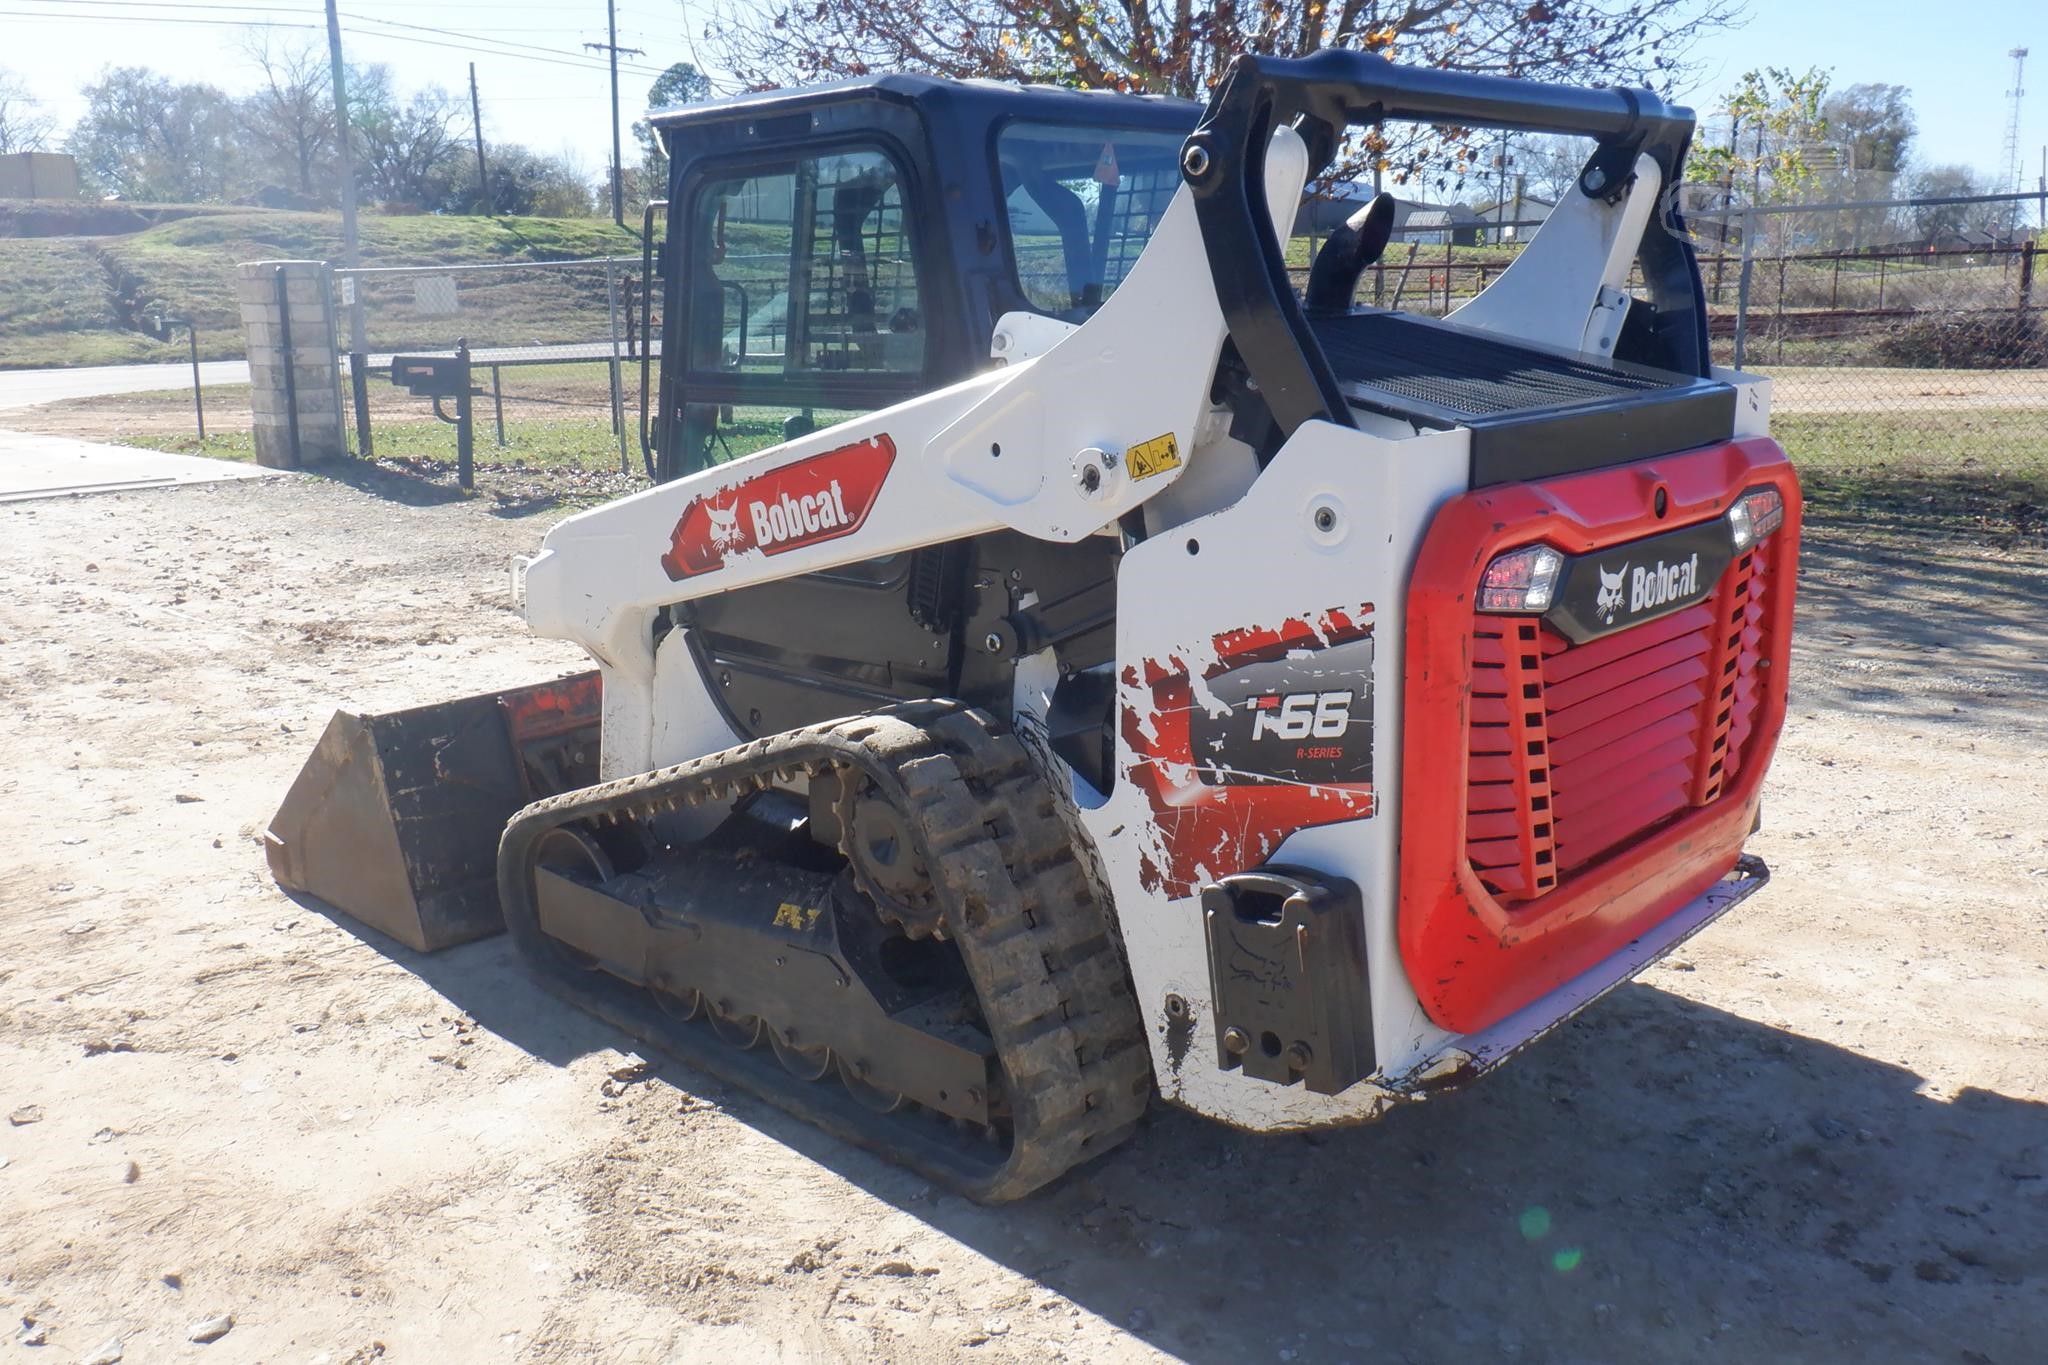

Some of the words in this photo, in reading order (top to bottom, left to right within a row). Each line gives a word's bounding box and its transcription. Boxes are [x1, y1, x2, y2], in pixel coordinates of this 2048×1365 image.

[749, 480, 848, 547] Bobcat
[1630, 552, 1698, 613] Bobcat
[1296, 746, 1343, 760] R-SERIES
